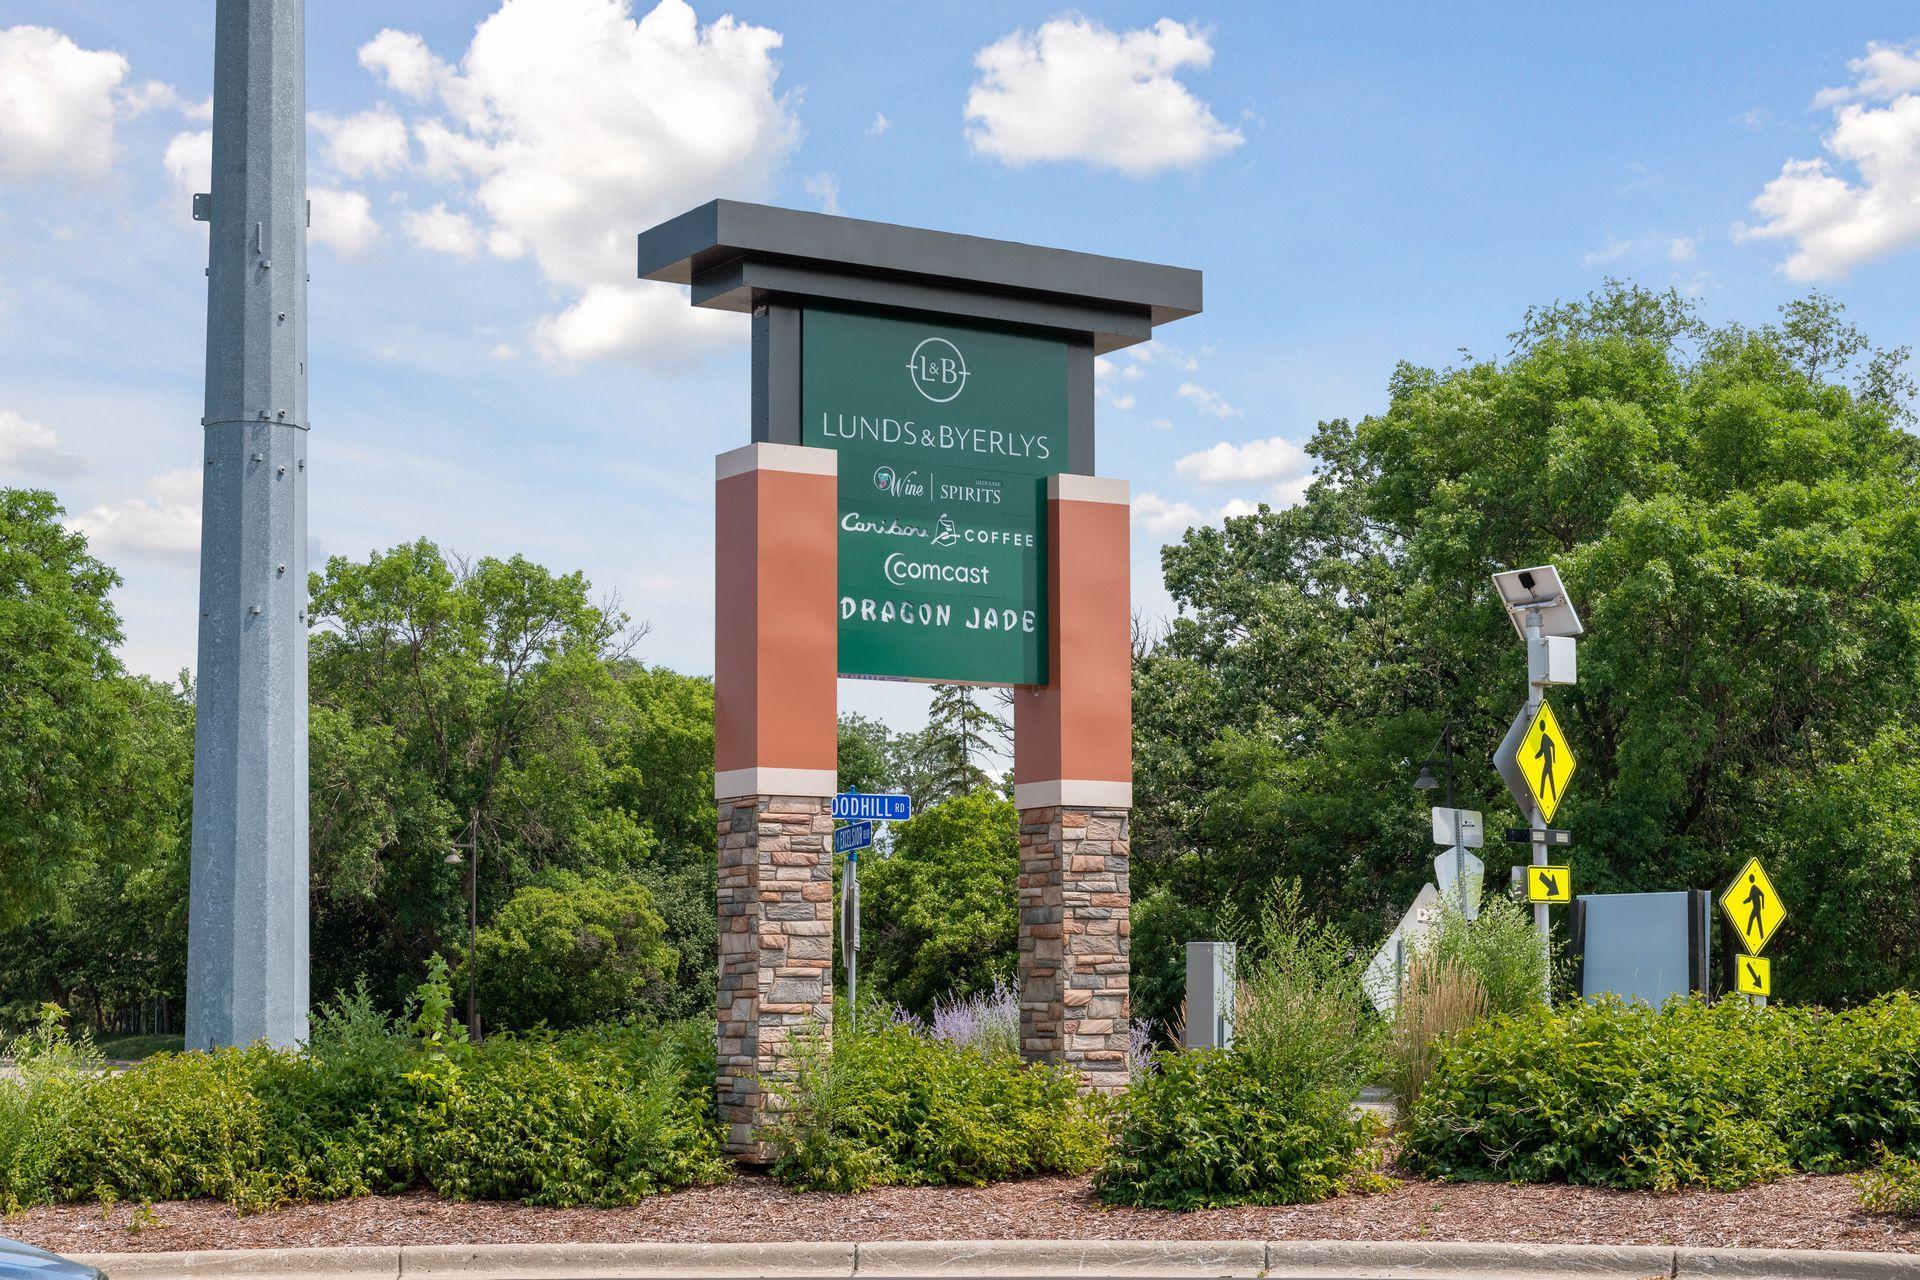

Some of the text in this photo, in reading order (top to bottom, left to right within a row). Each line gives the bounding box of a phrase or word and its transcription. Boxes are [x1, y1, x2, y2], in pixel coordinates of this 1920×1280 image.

[919, 355, 958, 384] L&B
[823, 412, 1049, 459] LUNDS&BYERLYS
[889, 471, 924, 498] Wine
[940, 484, 1001, 504] SPIRITS
[841, 512, 1034, 547] Caribou COFFEE
[840, 597, 1036, 632] DRAGON JADE
[832, 797, 905, 817] OODHILL RD
